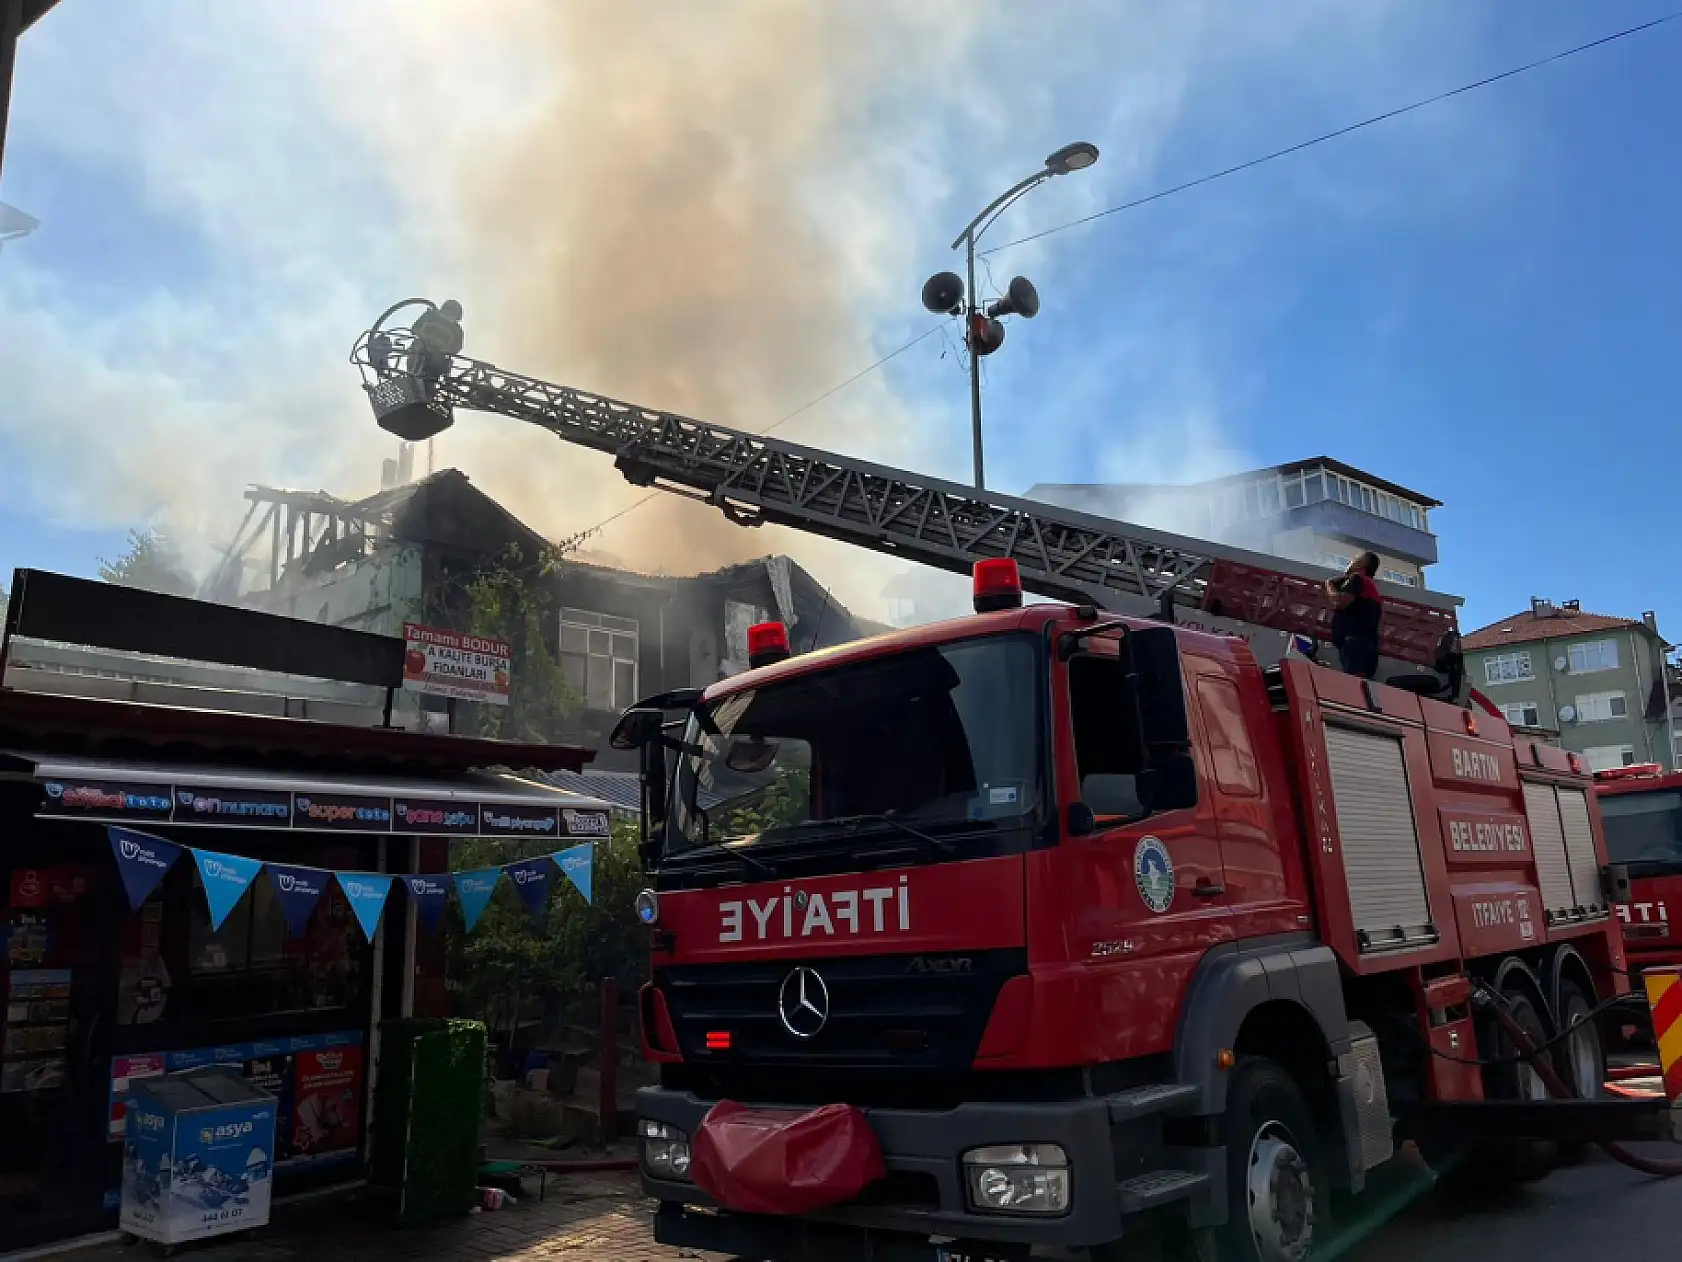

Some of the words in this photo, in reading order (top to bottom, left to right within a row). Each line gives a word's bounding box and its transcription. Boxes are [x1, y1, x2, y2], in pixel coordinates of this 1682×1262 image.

[462, 636, 509, 656] BODUR
[1451, 748, 1500, 782] BARTIN
[215, 1122, 253, 1138] asya
